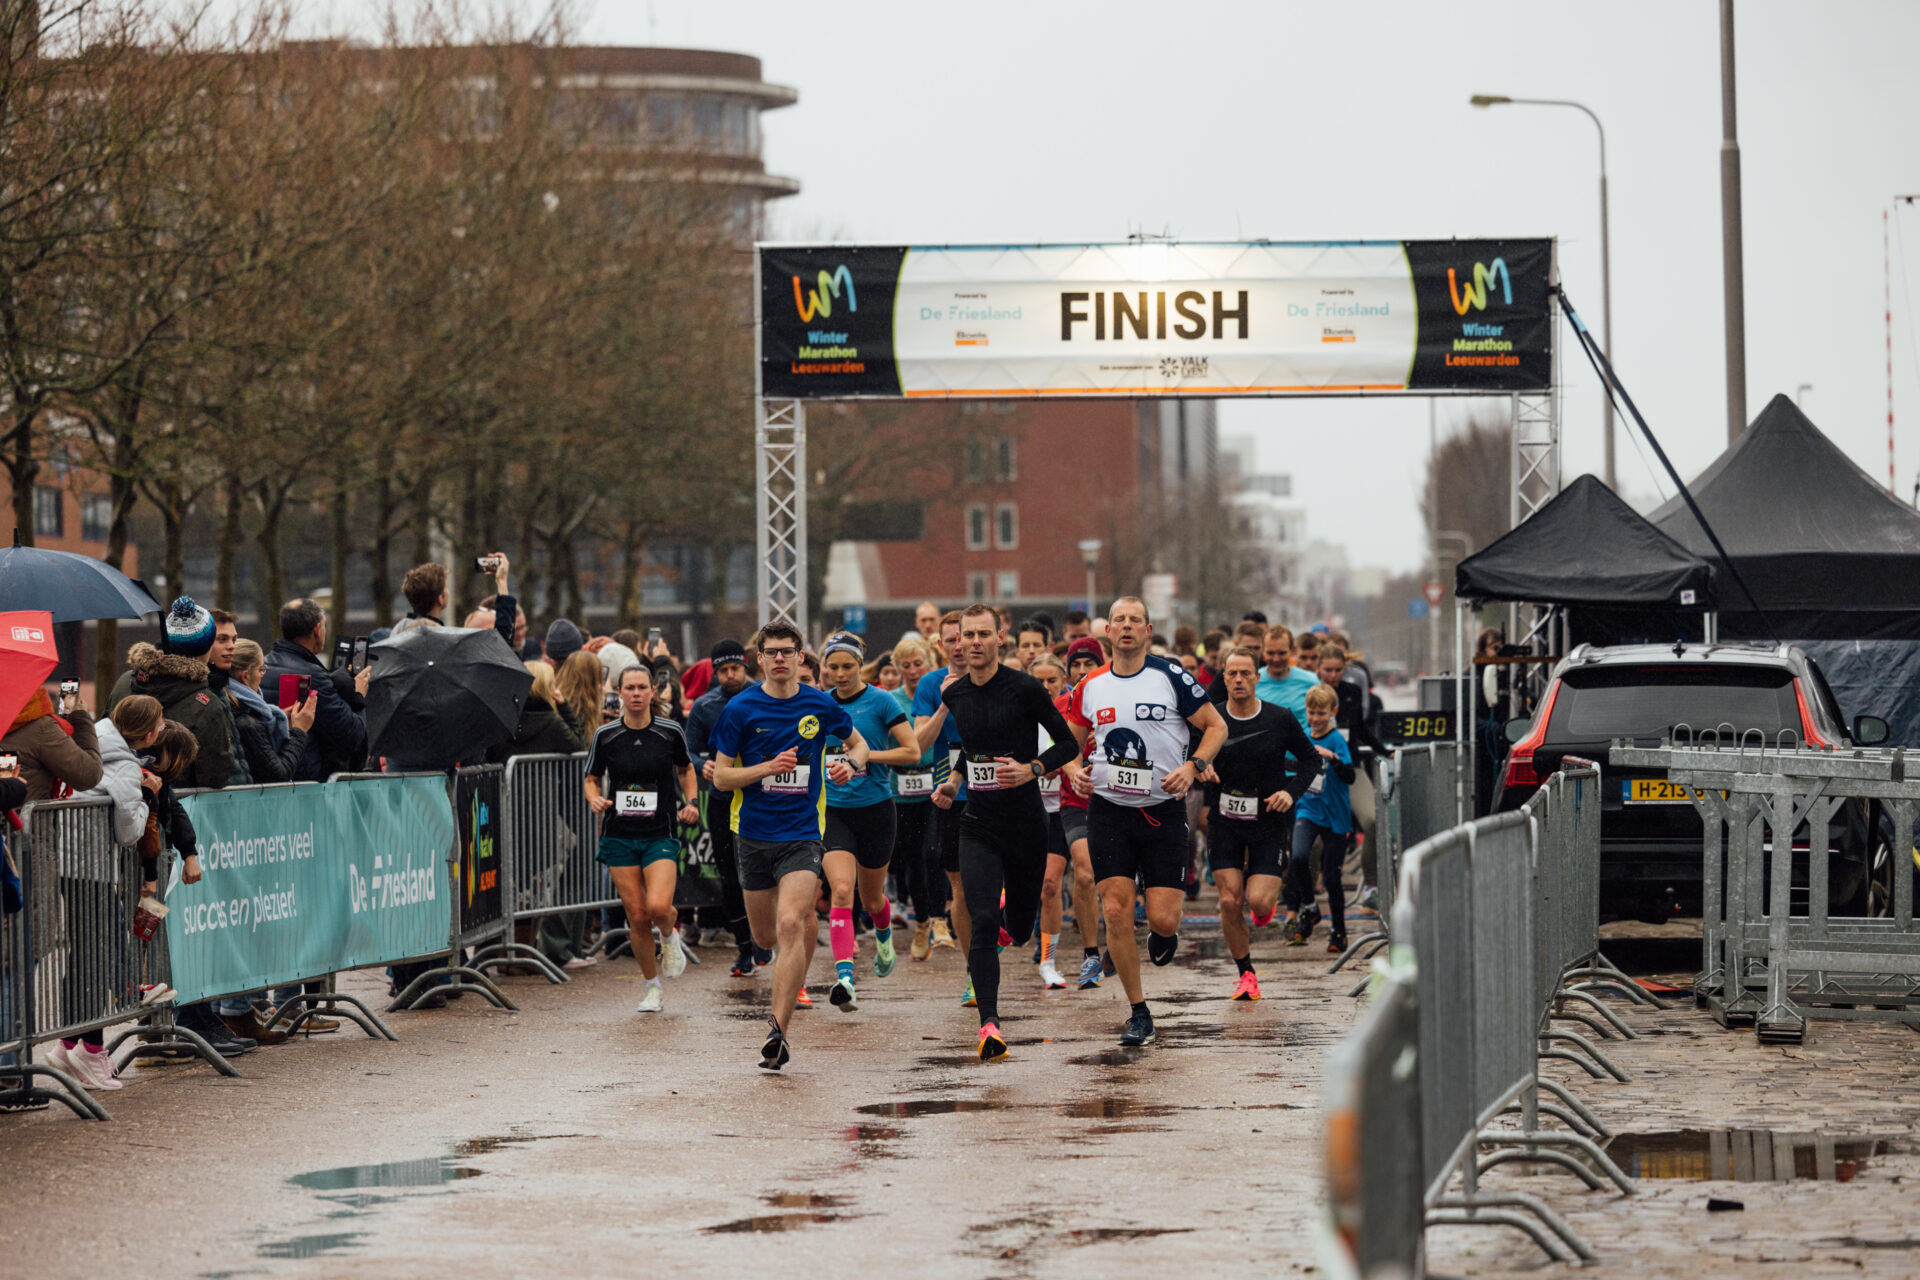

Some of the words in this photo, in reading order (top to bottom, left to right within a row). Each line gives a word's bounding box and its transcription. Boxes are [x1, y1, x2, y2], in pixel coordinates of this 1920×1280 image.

[920, 307, 942, 320] De
[949, 305, 1022, 320] Friesland
[1061, 291, 1248, 341] FINISH
[1287, 303, 1309, 317] De
[1316, 302, 1390, 317] Friesland
[1462, 323, 1504, 336] Winter
[807, 330, 849, 344] Winter
[1453, 337, 1513, 351] Marathon
[799, 345, 858, 359] Marathon
[1445, 352, 1520, 366] Leeuwarden
[792, 360, 865, 374] Leeuwarden
[973, 767, 995, 781] 537
[1118, 771, 1138, 786] 531
[905, 778, 923, 789] 533
[625, 795, 646, 808] 564
[1228, 799, 1247, 813] 576
[208, 829, 287, 871] deelnemers
[288, 821, 315, 861] veel
[350, 863, 368, 914] De
[371, 849, 436, 911] Friesland
[184, 898, 228, 936] succes
[229, 896, 250, 927] en
[252, 882, 297, 933] plezier!
